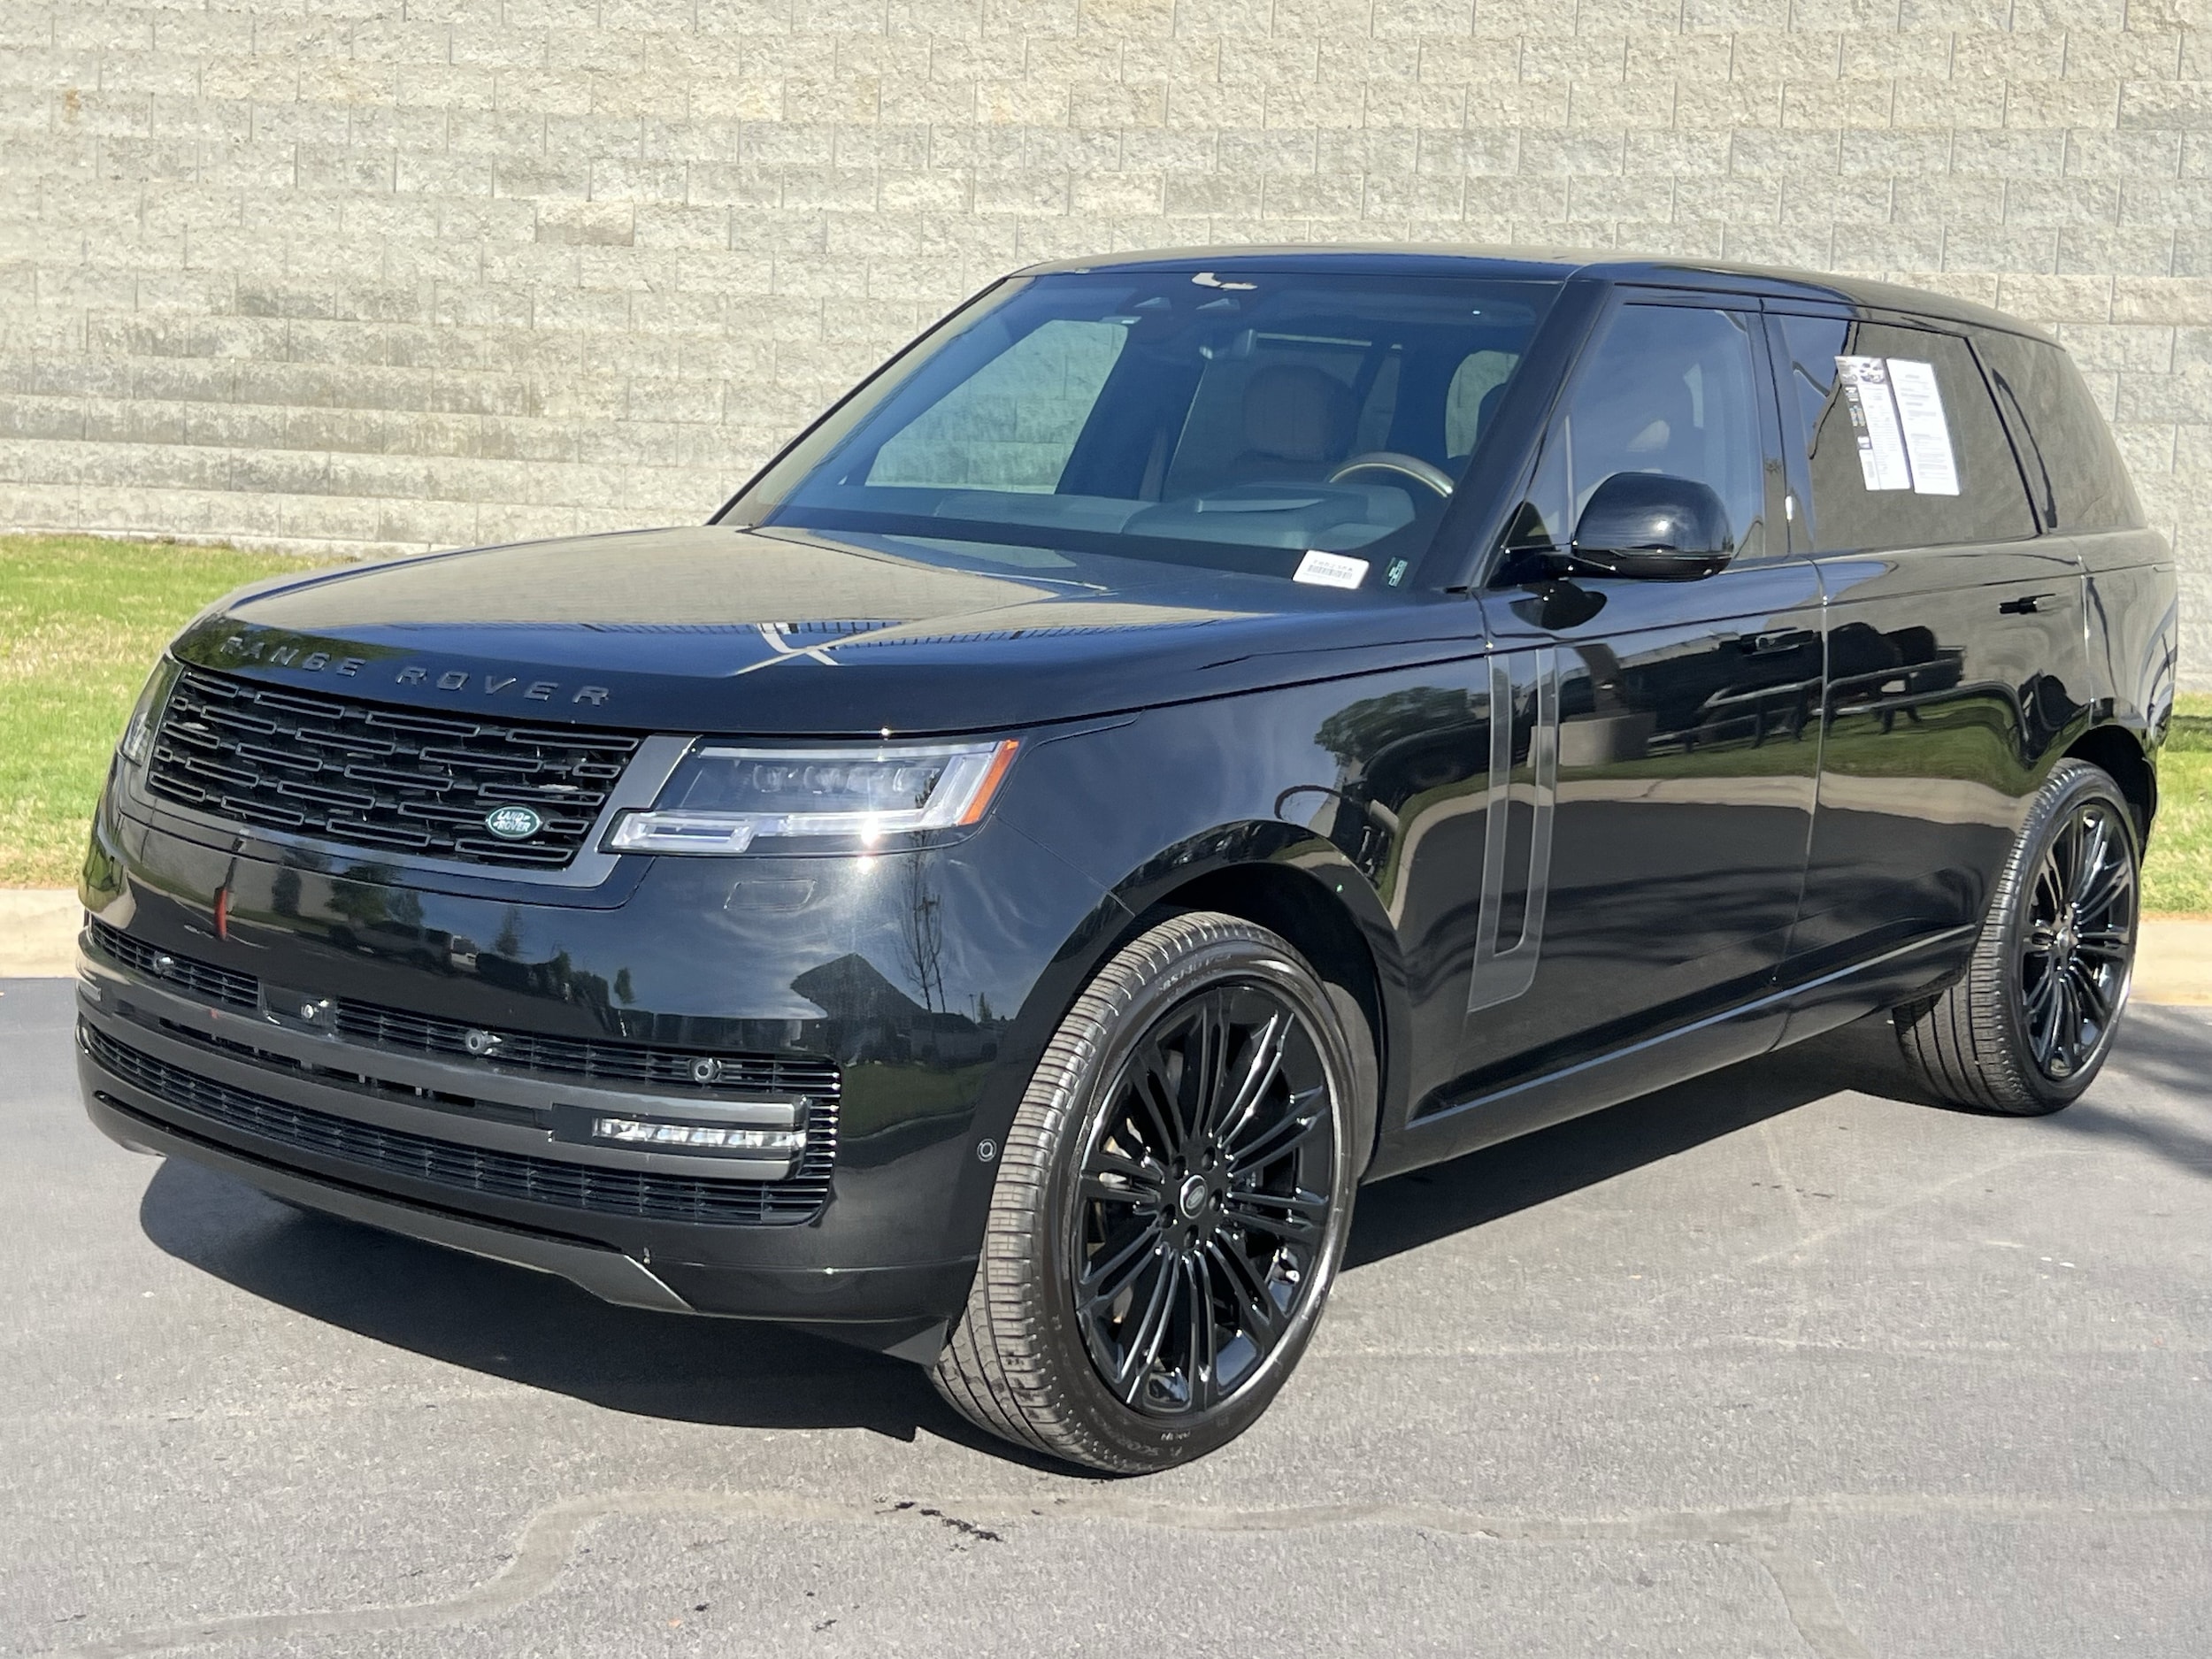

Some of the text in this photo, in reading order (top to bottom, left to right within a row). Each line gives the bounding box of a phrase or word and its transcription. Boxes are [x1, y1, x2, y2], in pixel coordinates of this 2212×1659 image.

[220, 635, 610, 706] RANGE ROVER
[497, 810, 525, 821] LAND
[495, 820, 531, 832] ROVER
